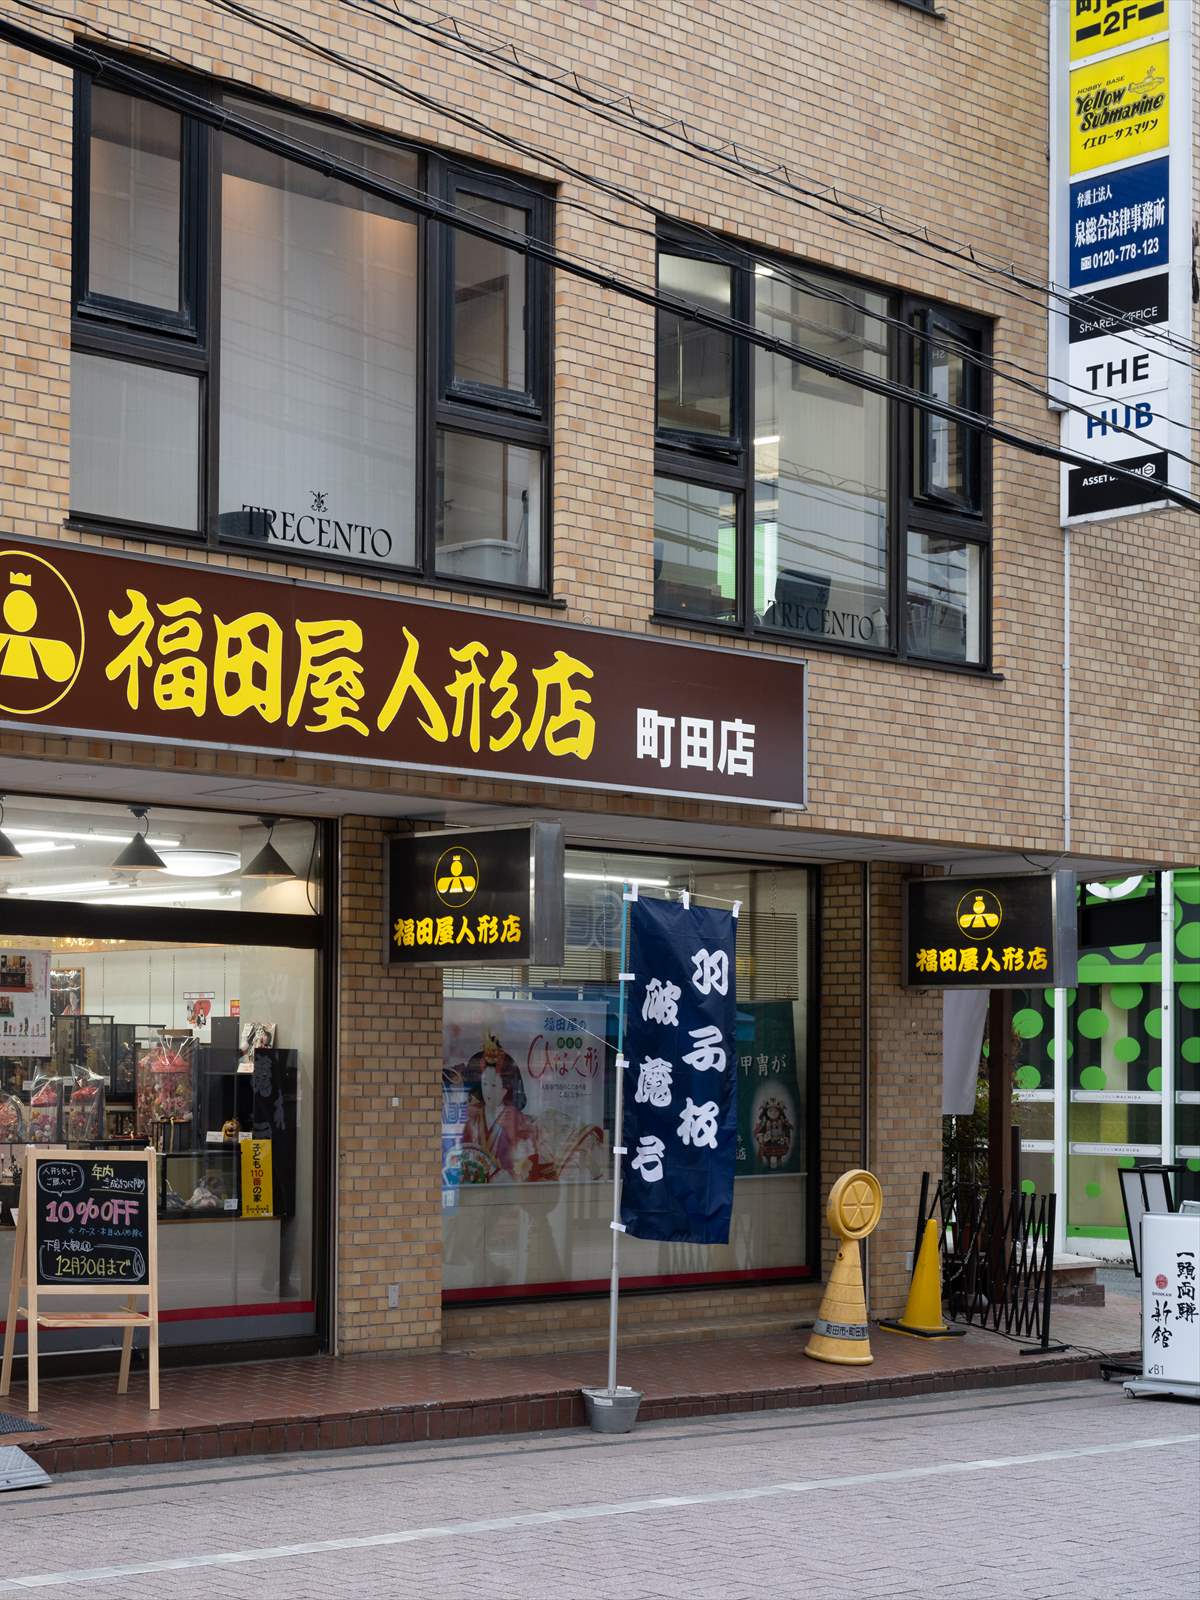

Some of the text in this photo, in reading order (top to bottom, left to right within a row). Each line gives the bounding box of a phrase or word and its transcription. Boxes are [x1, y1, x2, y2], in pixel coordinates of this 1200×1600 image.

[1103, 4, 1138, 36] 2F
[1075, 87, 1126, 116] Yellow
[1080, 93, 1166, 132] Submarine
[1082, 119, 1158, 150] イエローサブマリン
[1077, 184, 1112, 208] 弁護士法人
[1075, 197, 1165, 247] 泉総合法律事務所
[1093, 237, 1159, 269] 0120-778-123
[1086, 354, 1149, 390] THE
[1087, 402, 1153, 439] HUB
[1082, 474, 1108, 486] ASSET
[242, 503, 392, 558] TRECENTO
[768, 600, 874, 640] TRECENTO
[105, 588, 756, 778] 福田屋人形店 町田店
[394, 914, 522, 947] 福田屋人形店
[915, 946, 1049, 973] 福田屋人形店
[677, 948, 729, 1149] 羽子板
[91, 1163, 114, 1181] 年内
[45, 1197, 140, 1226] 10%OFF
[55, 1255, 131, 1276] 12月30日まで
[1151, 1299, 1173, 1349] 新館
